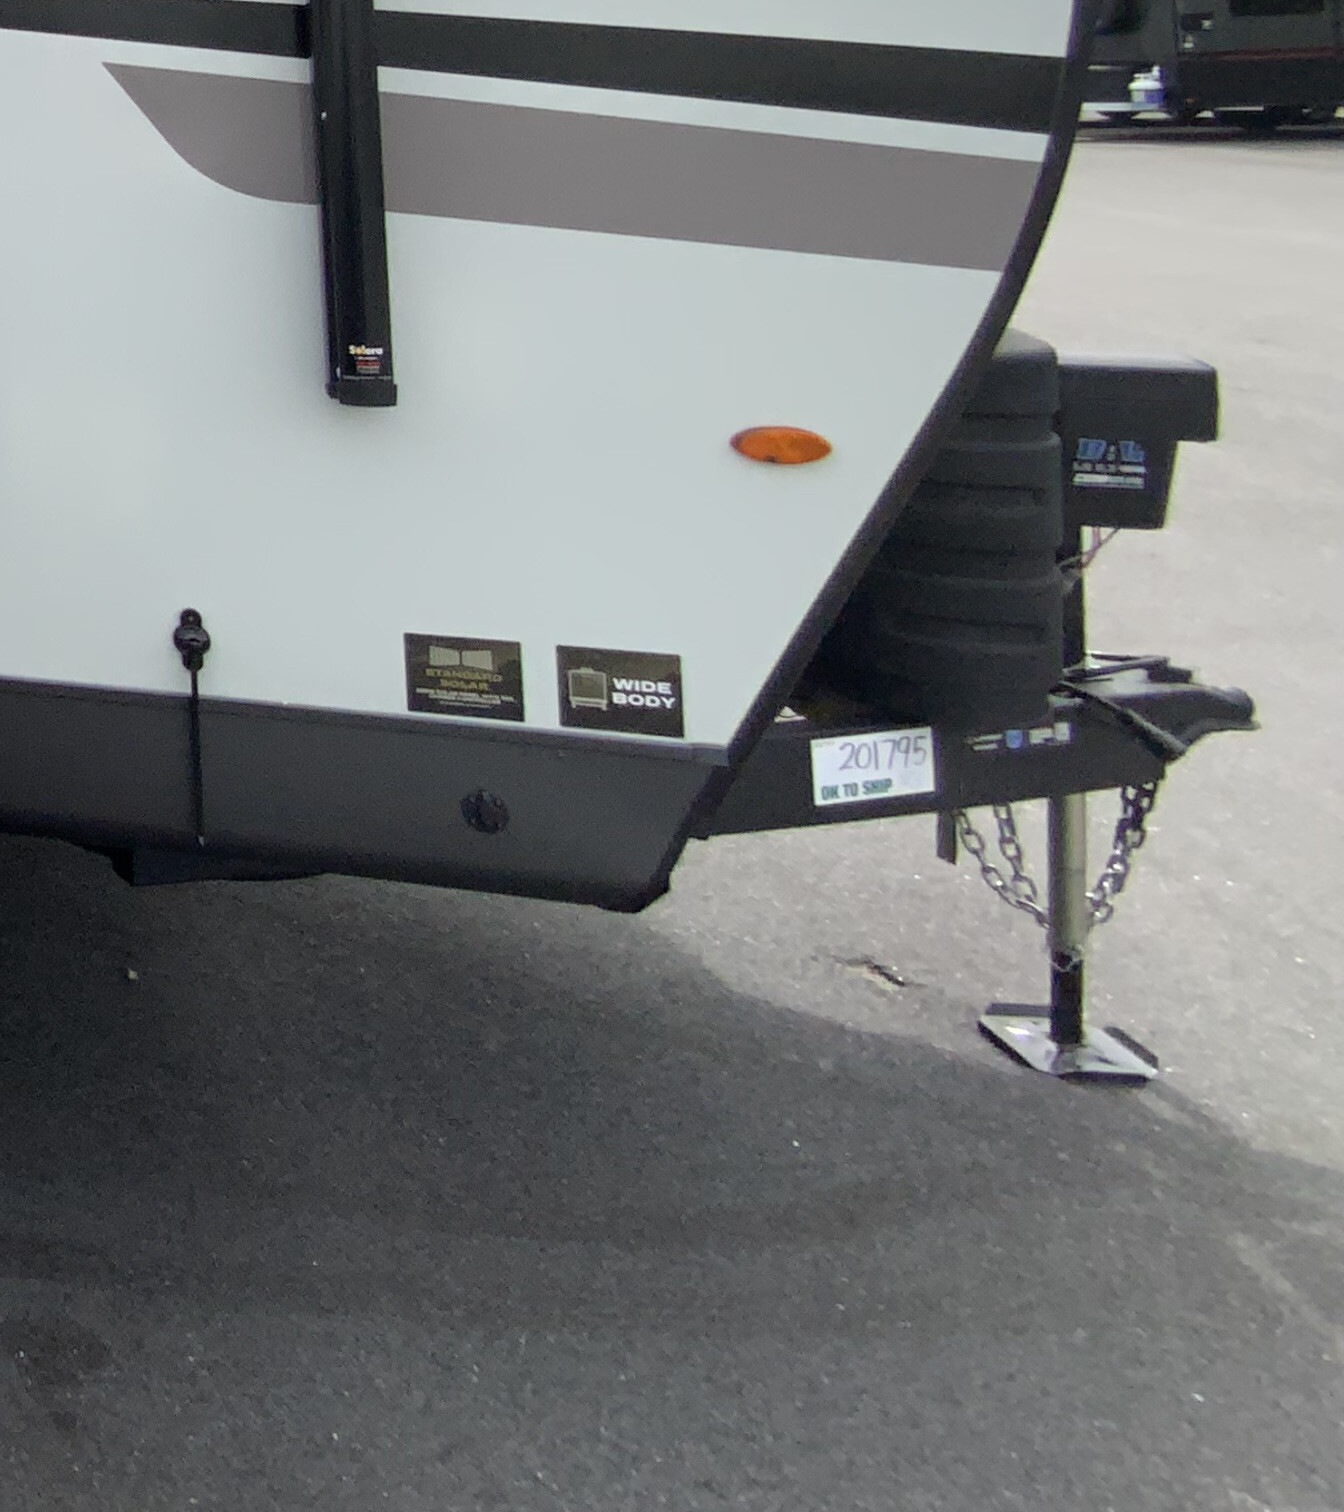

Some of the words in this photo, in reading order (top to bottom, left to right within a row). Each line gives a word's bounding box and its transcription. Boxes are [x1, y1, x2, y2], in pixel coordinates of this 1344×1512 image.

[612, 677, 673, 695] WIDE
[612, 691, 676, 709] BODY
[838, 735, 928, 771] 201795
[821, 784, 840, 801] OK
[842, 782, 859, 798] TO
